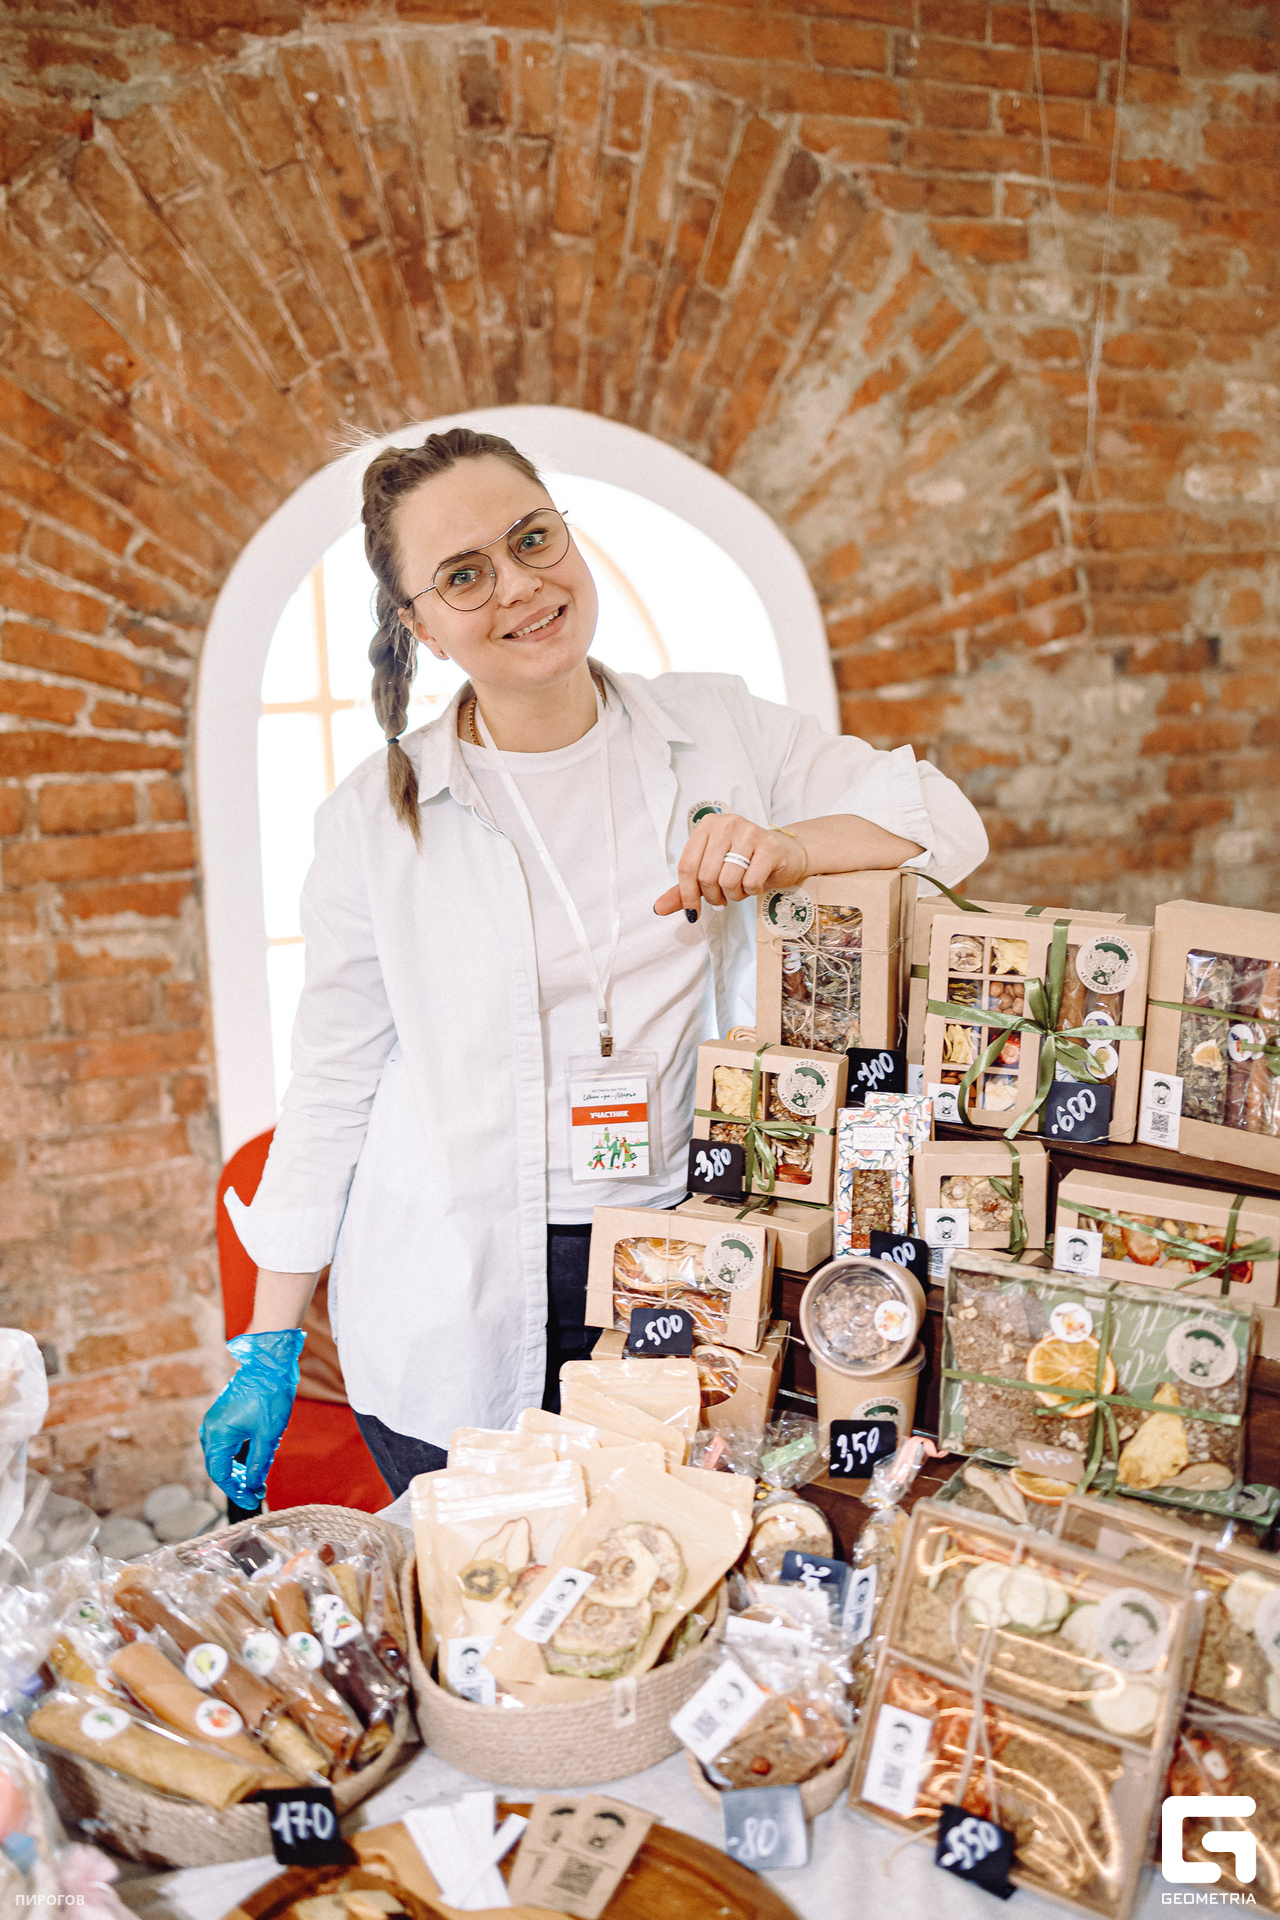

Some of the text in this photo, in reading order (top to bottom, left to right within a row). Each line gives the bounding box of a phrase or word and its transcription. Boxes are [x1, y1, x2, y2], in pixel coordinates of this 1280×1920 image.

[1100, 935, 1132, 953] ФЕДОТИК
[1082, 974, 1114, 992] ECOSNACK
[800, 1060, 828, 1079] ФЕДОТИК
[783, 1096, 811, 1114] ECOSNACK
[590, 1110, 629, 1119] УЧАСТНИК
[726, 1232, 757, 1250] ФЕДОТИК
[710, 1272, 739, 1291] ECOSNACK
